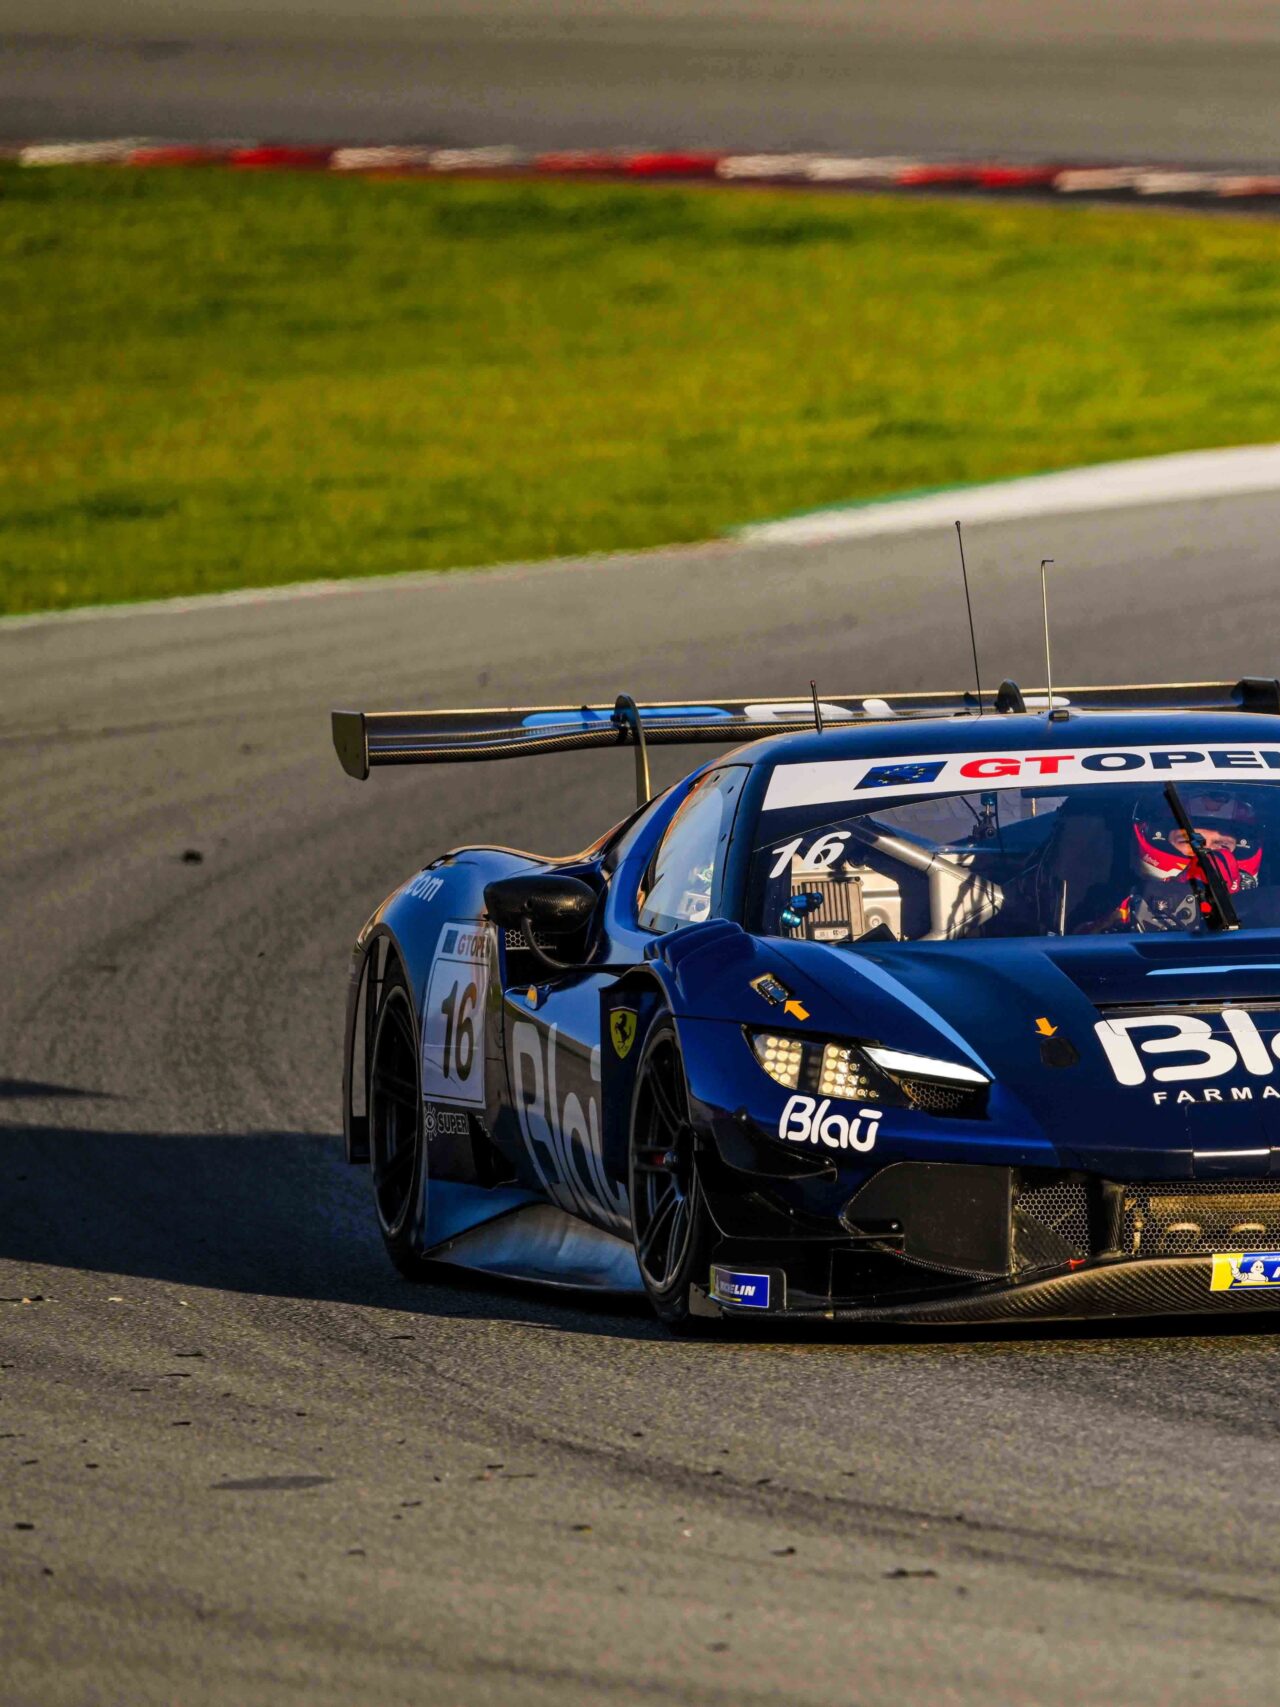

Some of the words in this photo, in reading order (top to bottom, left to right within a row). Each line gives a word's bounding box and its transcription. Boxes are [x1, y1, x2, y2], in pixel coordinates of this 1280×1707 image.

[769, 831, 852, 879] 16
[441, 980, 477, 1082] 16
[779, 1095, 883, 1152] Blaū
